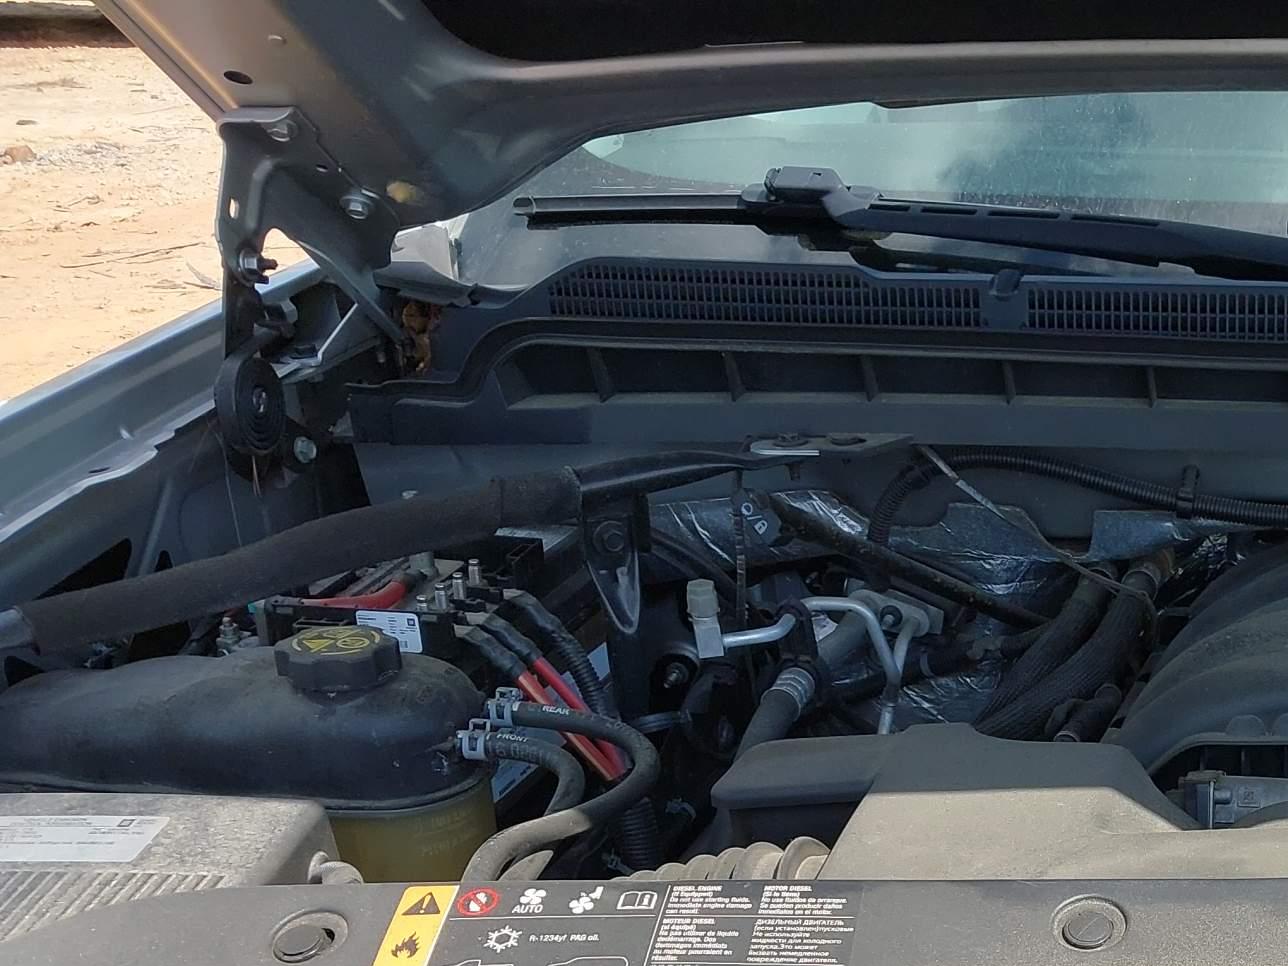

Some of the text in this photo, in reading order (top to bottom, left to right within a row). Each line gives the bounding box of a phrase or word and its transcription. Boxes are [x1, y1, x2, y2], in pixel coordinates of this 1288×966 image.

[542, 705, 570, 715] REAR
[496, 733, 528, 743] FRONT
[511, 904, 544, 914] AUTO
[529, 934, 567, 942] R-1234yf
[569, 933, 587, 941] PAG
